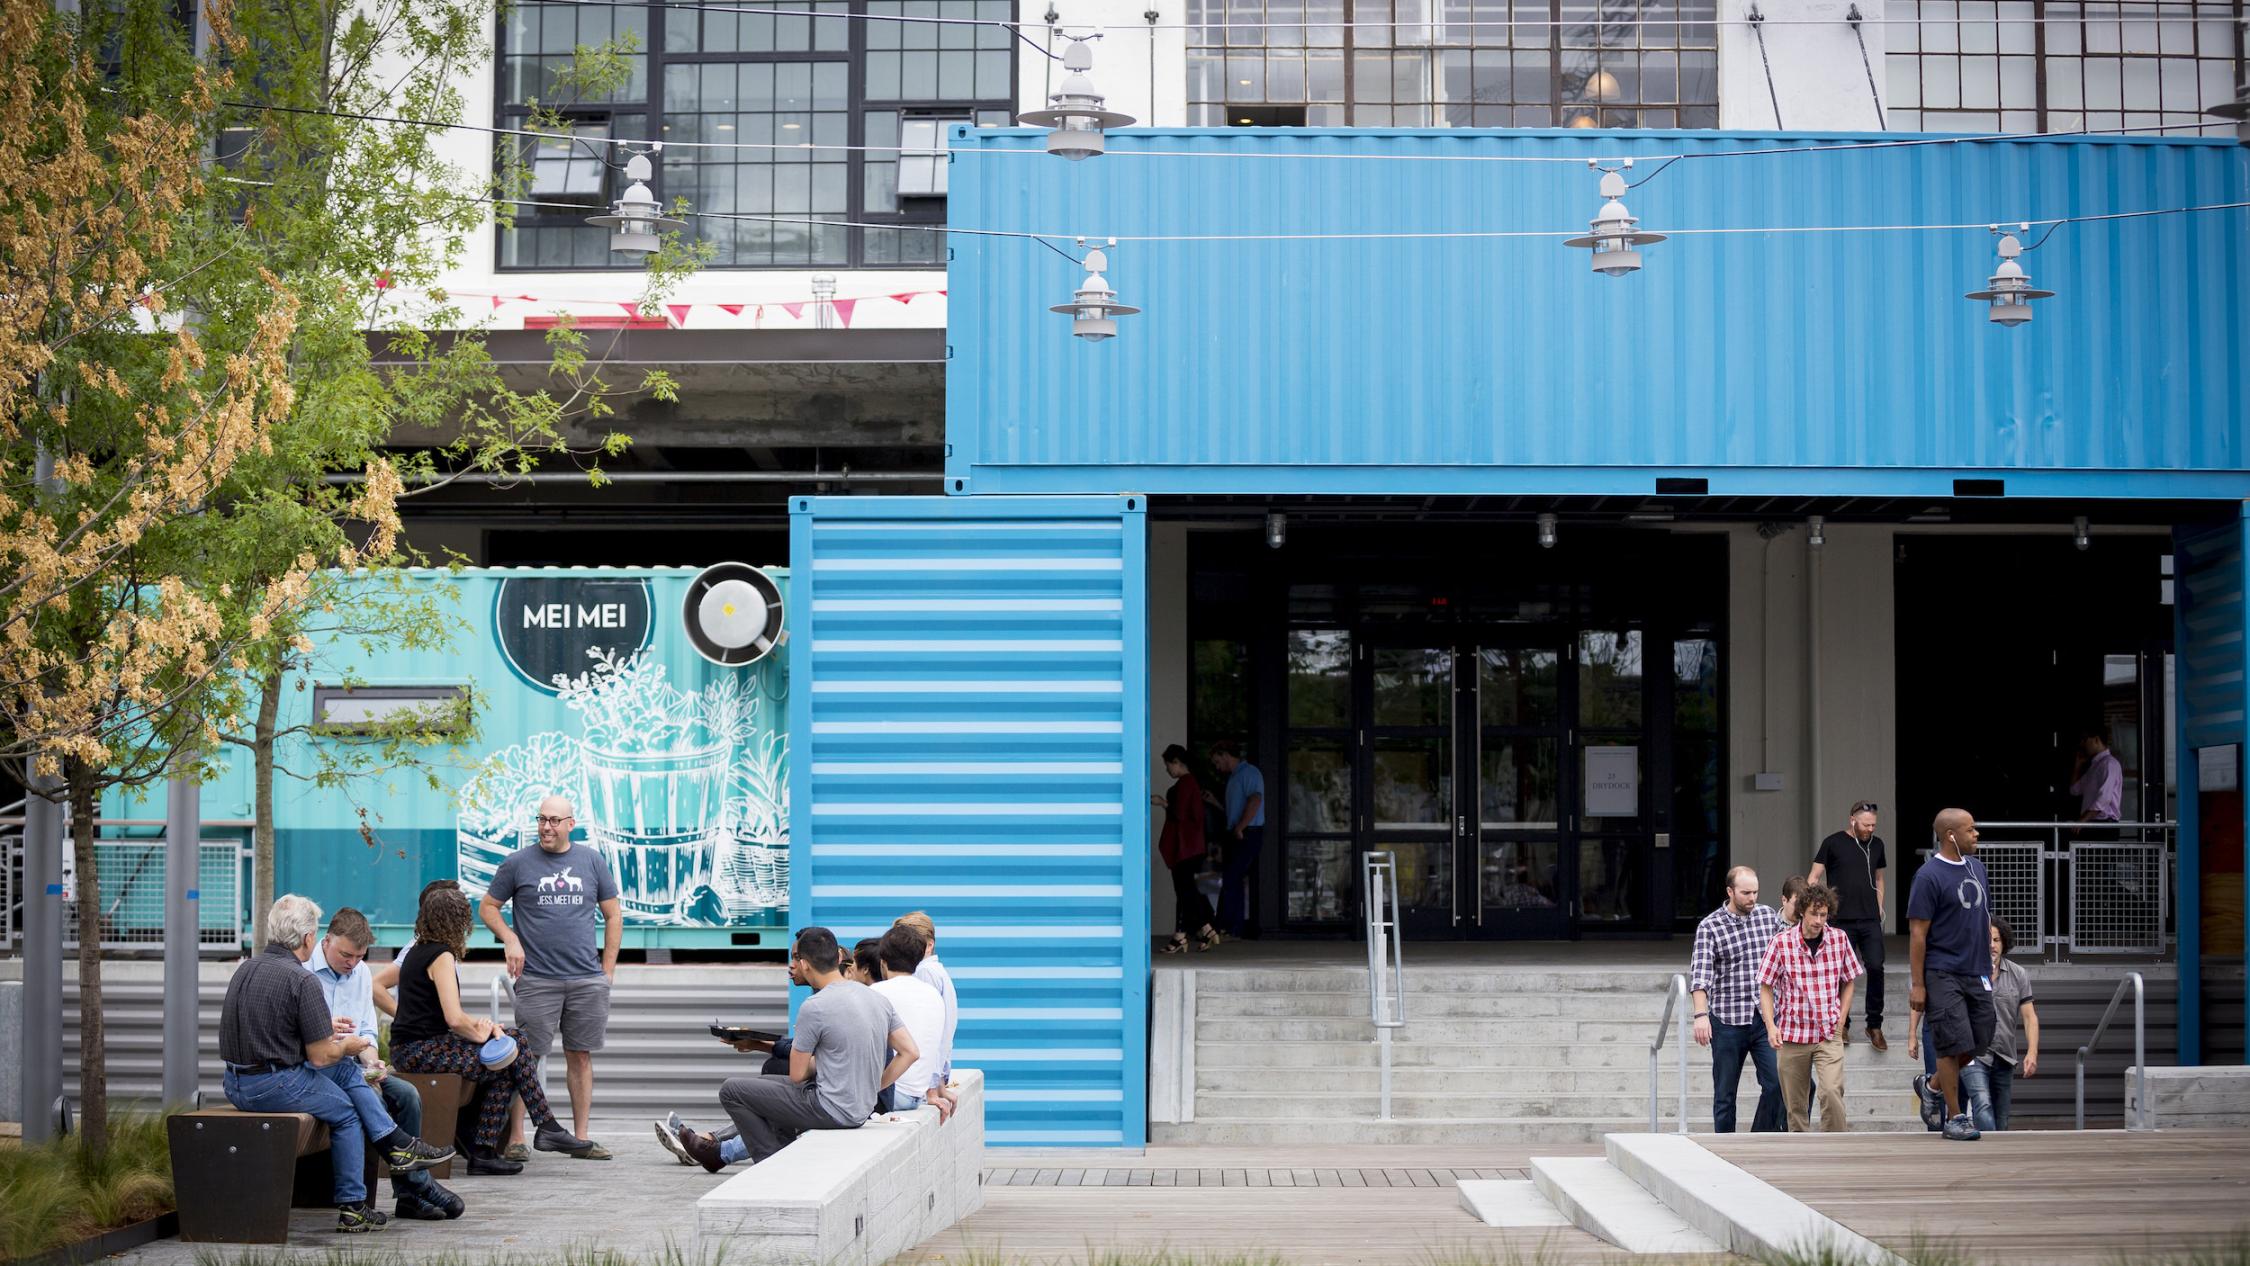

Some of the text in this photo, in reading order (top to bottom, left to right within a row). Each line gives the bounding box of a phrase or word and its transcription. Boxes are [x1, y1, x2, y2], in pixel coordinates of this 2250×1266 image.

[523, 603, 626, 629] MEI MEI
[554, 894, 571, 905] MEET
[571, 895, 584, 905] KEN
